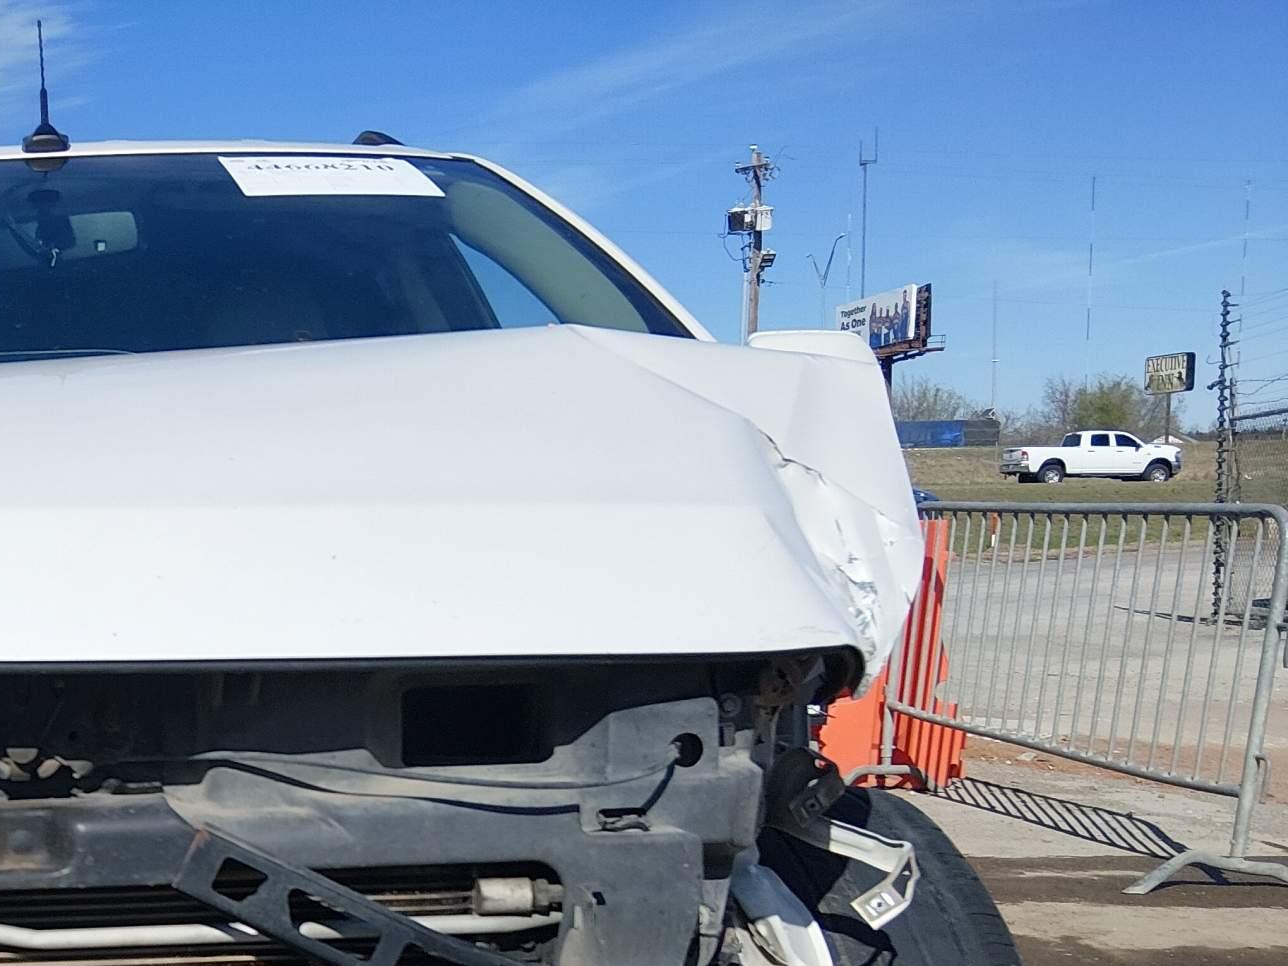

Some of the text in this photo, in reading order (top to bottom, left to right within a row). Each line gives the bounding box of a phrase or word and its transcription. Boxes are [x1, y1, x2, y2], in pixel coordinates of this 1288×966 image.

[840, 305, 867, 318] Together
[840, 318, 866, 331] As One
[1146, 356, 1185, 373] EXECUTIVE
